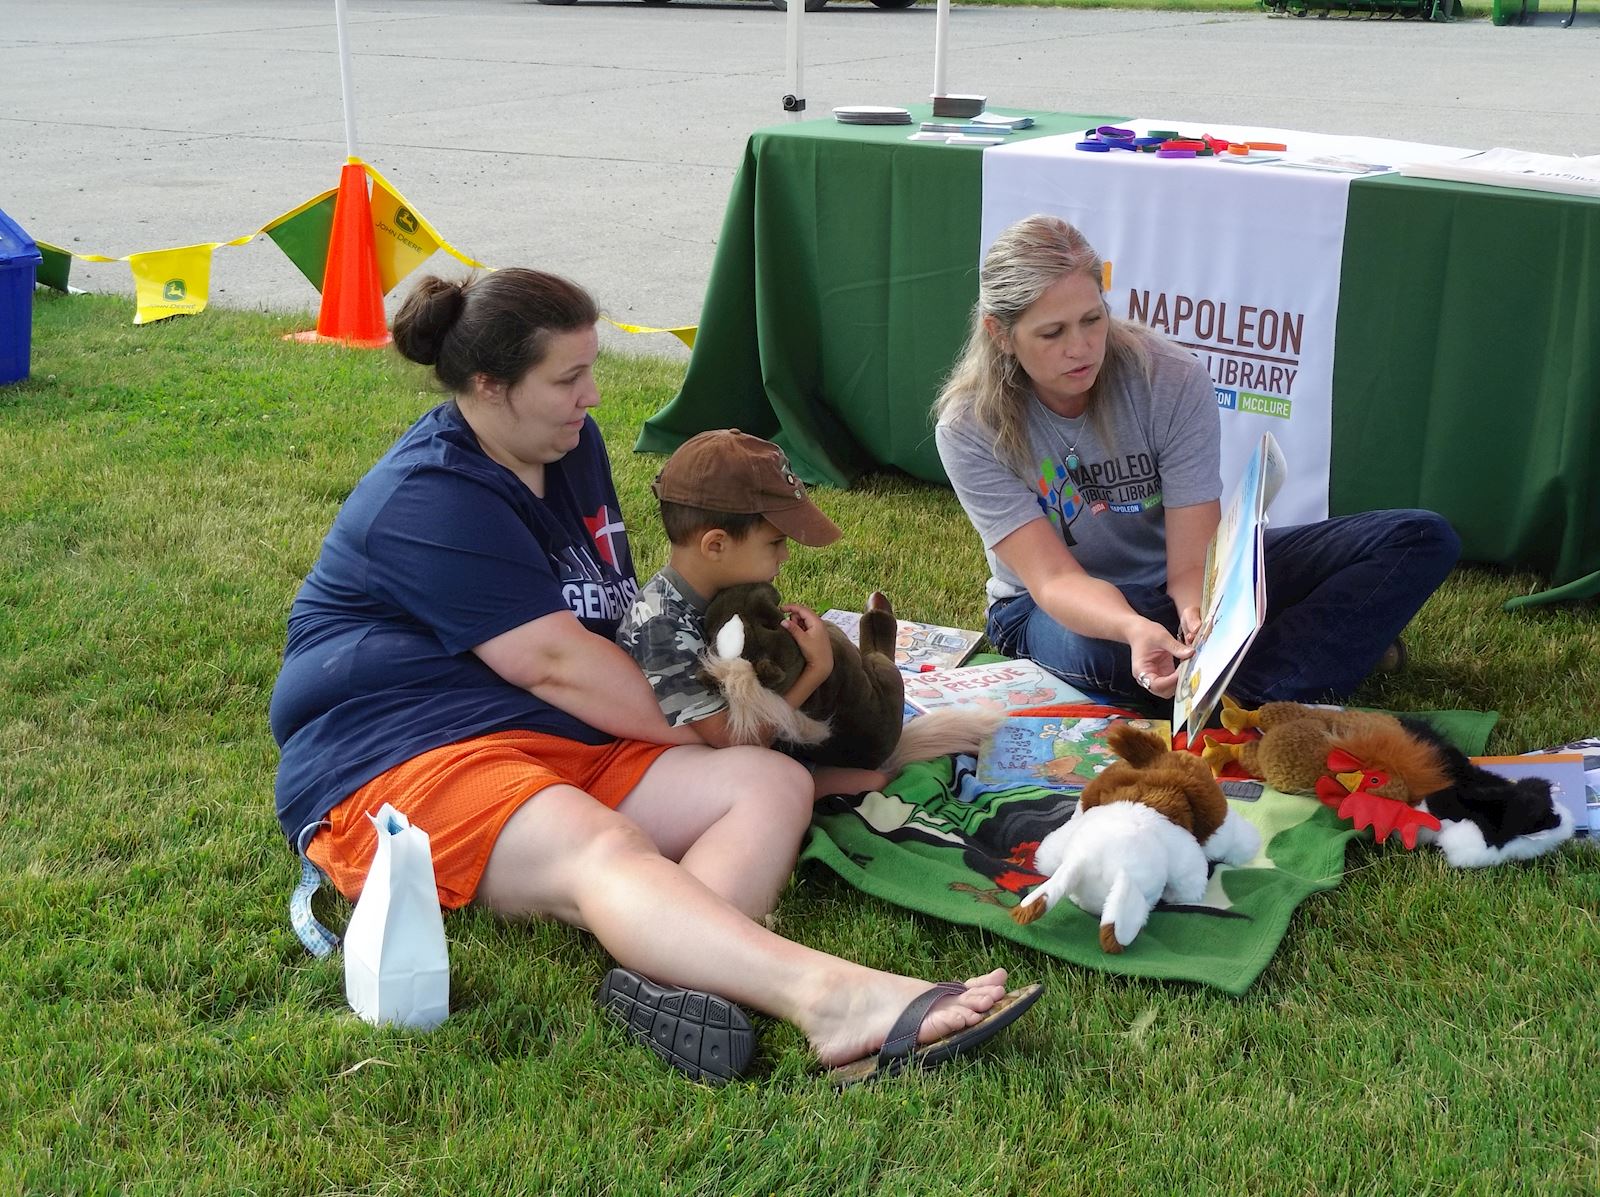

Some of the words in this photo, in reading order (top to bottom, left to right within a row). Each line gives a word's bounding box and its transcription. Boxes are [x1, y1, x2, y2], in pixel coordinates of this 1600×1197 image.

[397, 233, 423, 254] DEERE
[1128, 288, 1305, 355] NAPOLEON
[1206, 355, 1298, 396] LIBRARY
[1242, 396, 1290, 417] MCCLURE
[1070, 453, 1153, 487] NAPOLEO
[1081, 488, 1115, 505] UBLIC
[1119, 479, 1161, 503] LIBRAR
[943, 667, 1026, 693] RESCUE
